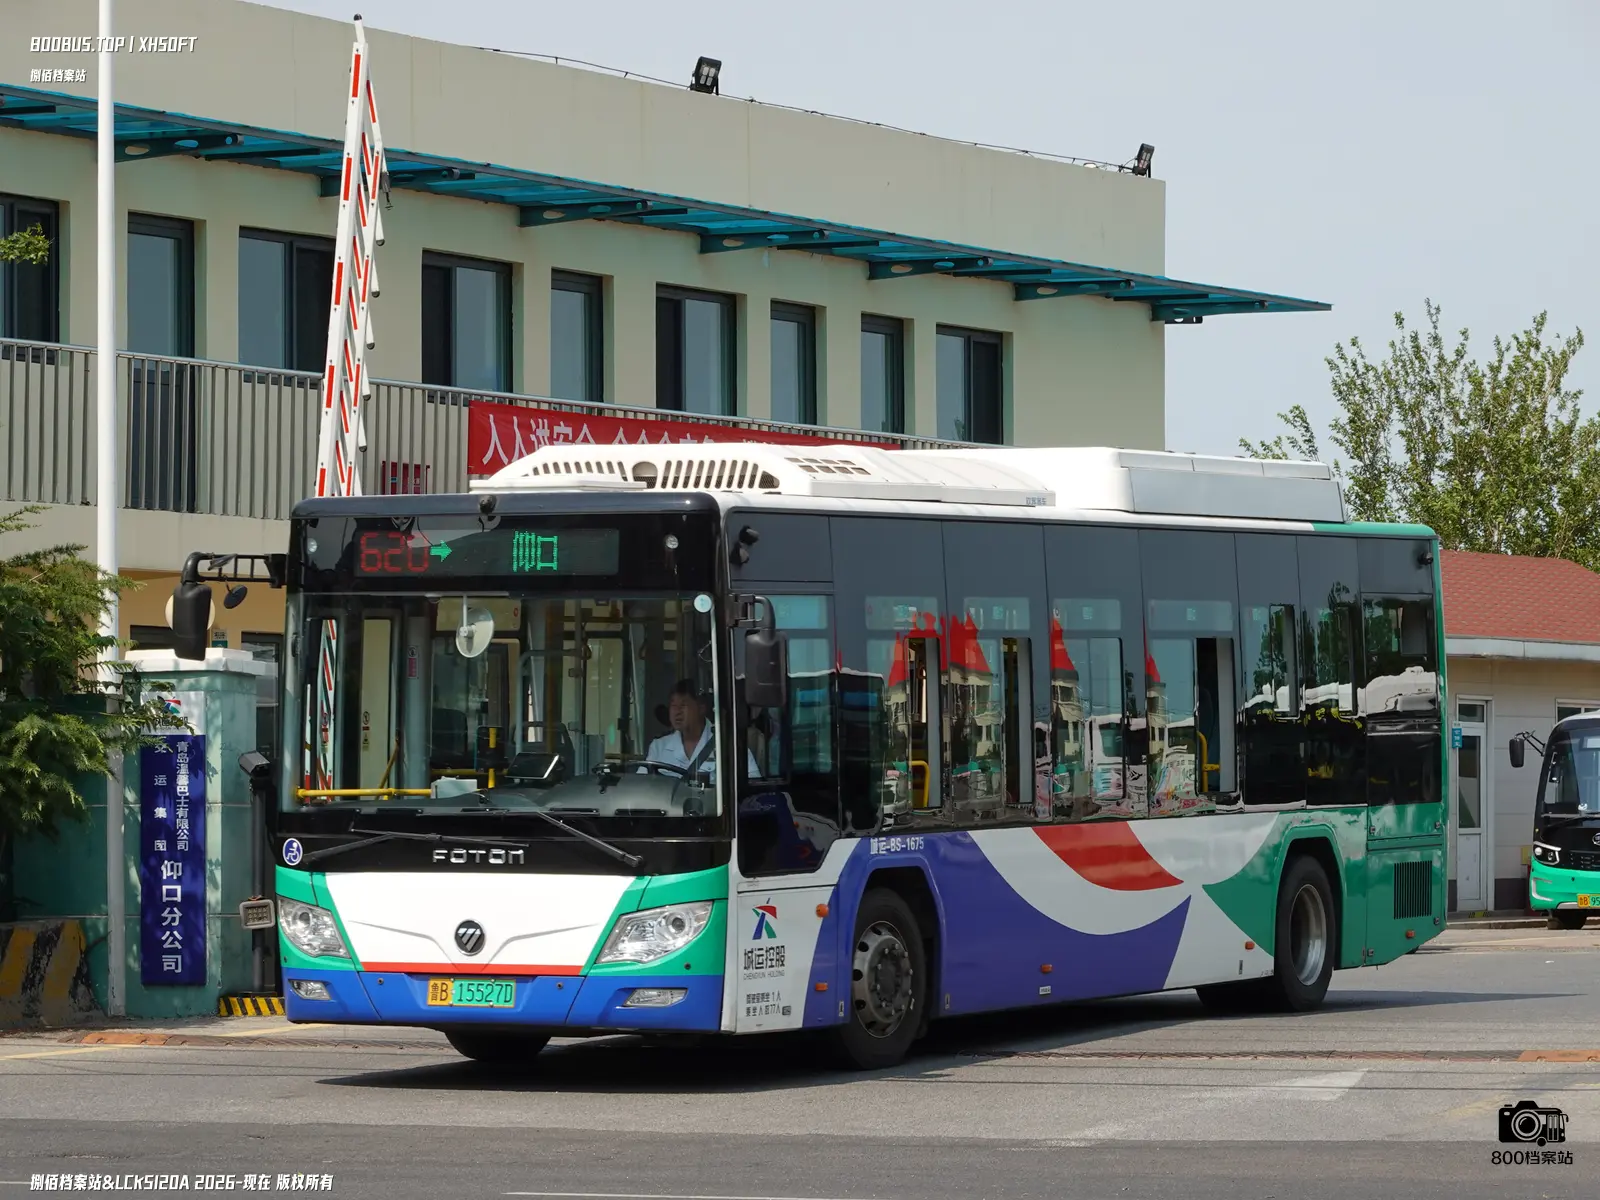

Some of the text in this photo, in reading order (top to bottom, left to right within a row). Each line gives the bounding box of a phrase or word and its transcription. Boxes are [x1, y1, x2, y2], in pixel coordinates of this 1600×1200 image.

[360, 531, 429, 572] 620
[433, 849, 525, 865] FOTON
[161, 860, 182, 973] 仰口分公司
[744, 945, 785, 970] 城运控股
